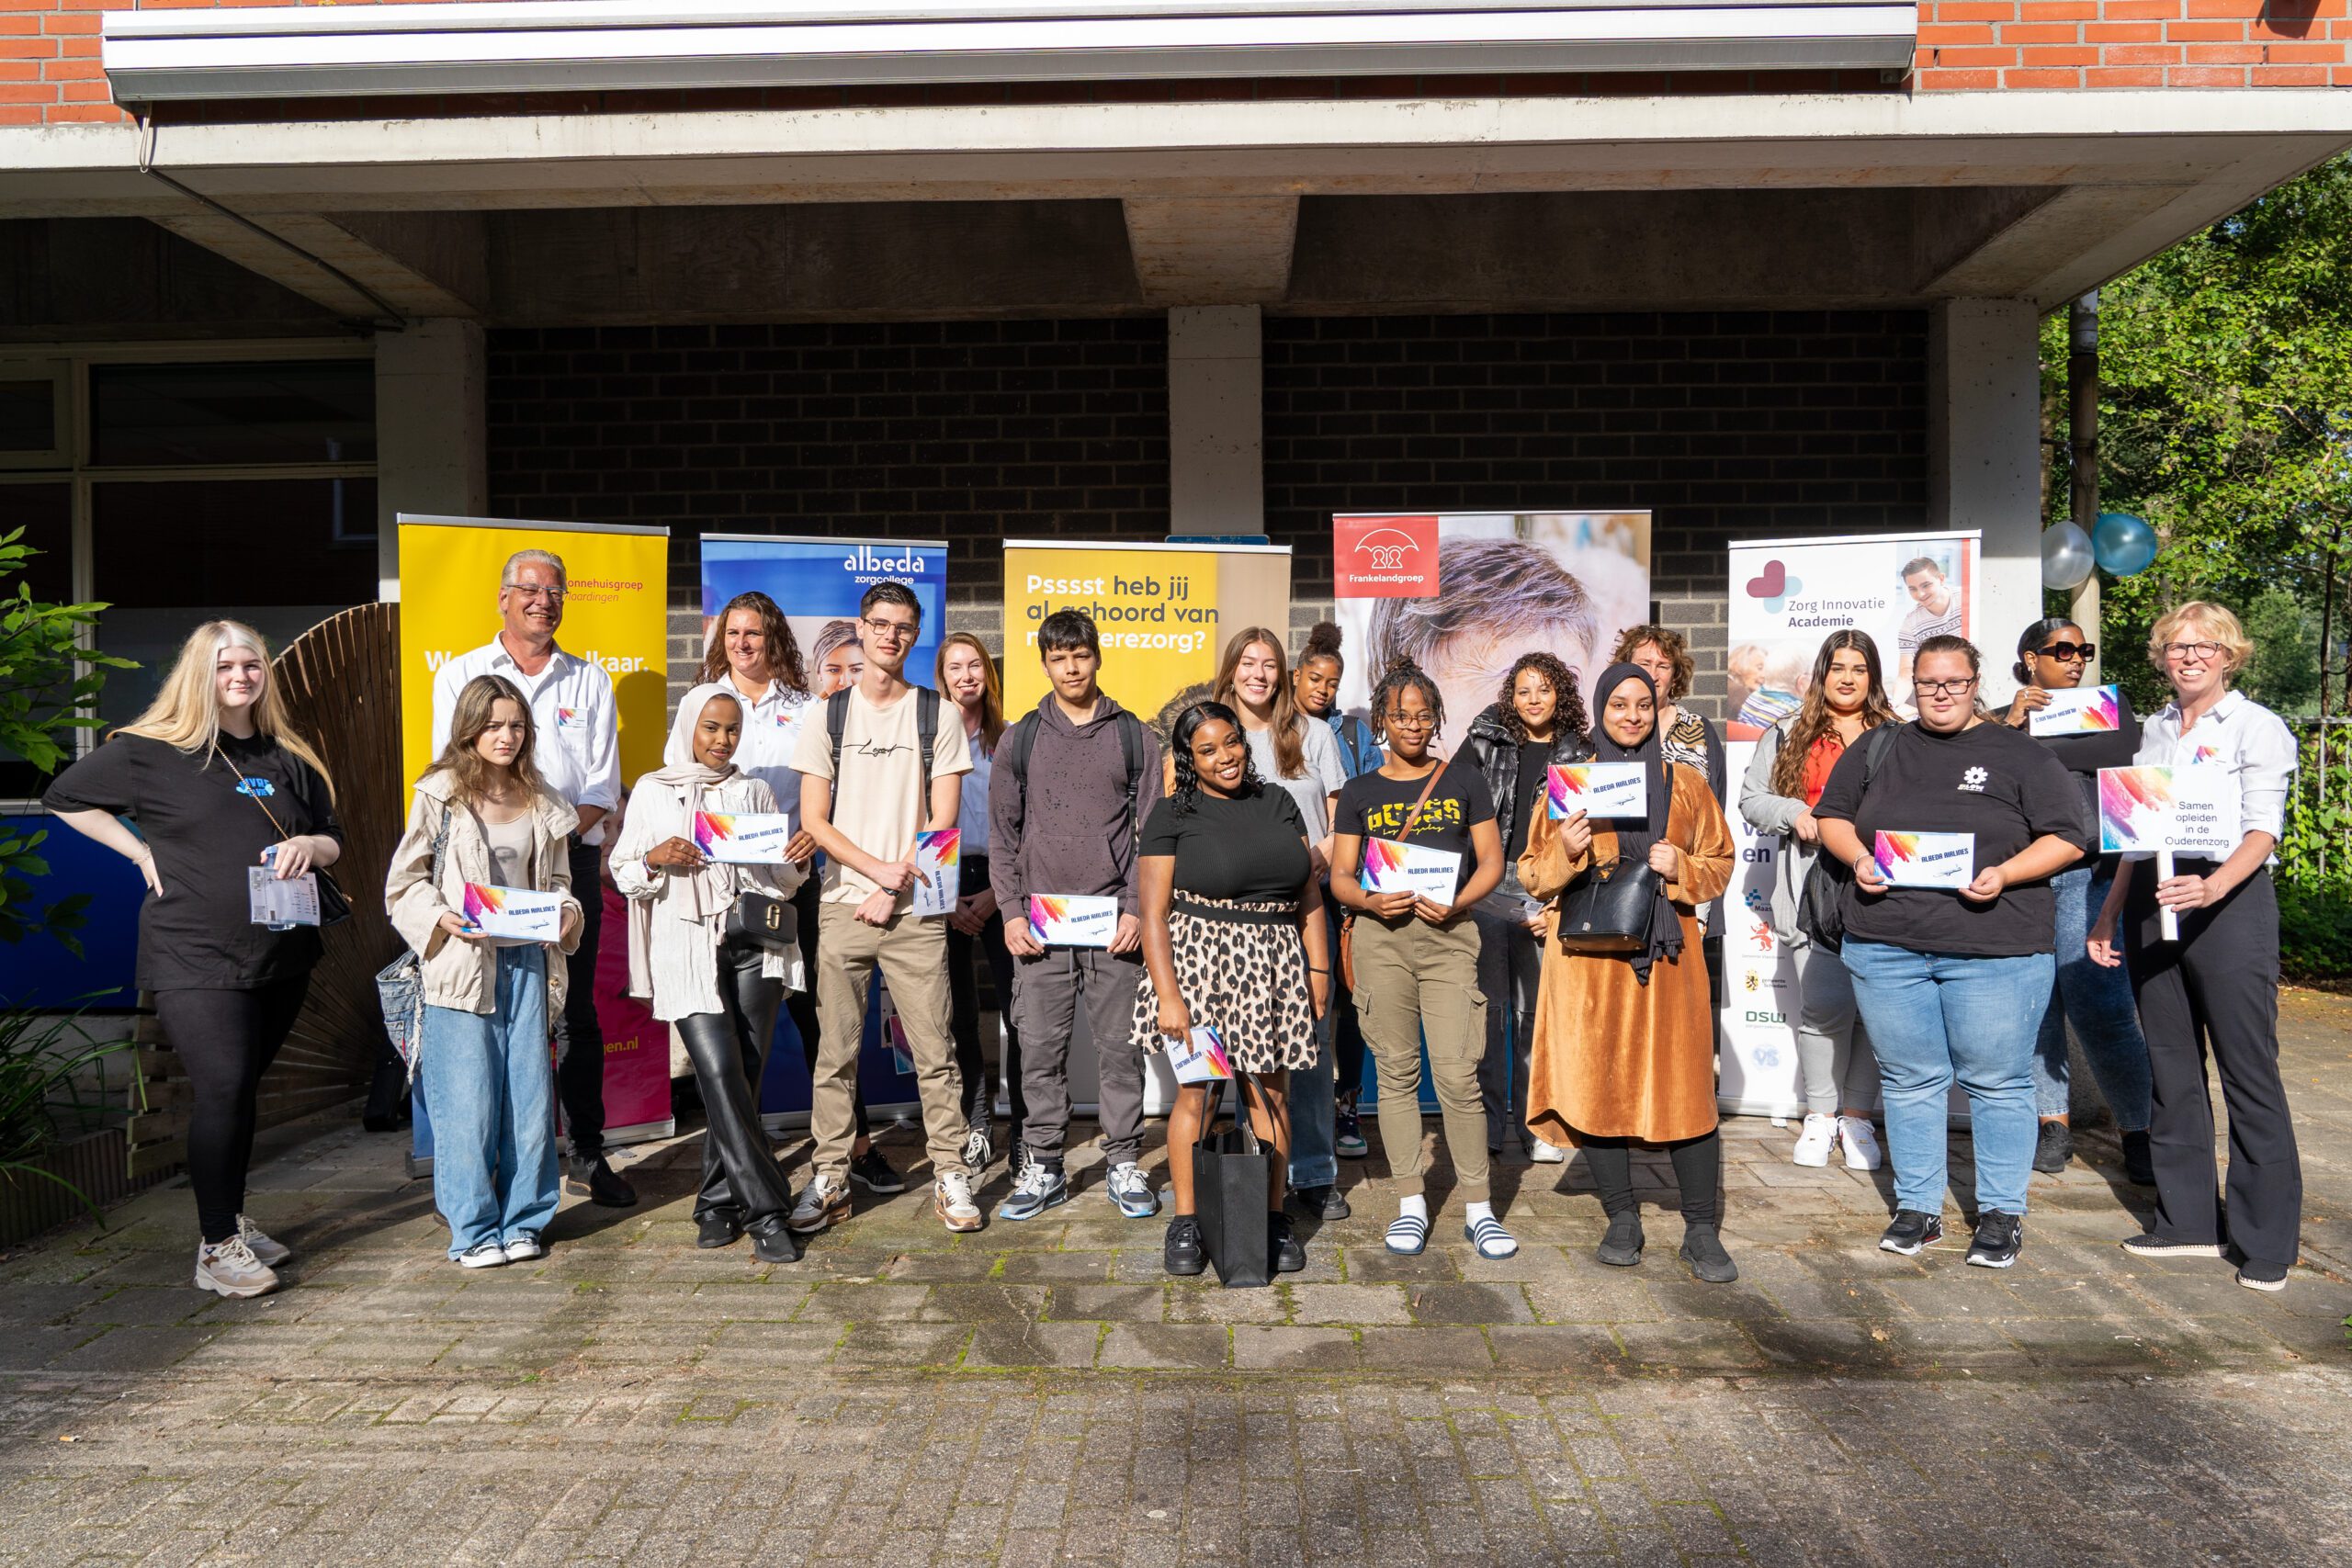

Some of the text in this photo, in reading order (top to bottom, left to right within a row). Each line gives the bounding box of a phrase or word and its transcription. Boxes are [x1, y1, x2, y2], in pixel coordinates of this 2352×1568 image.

[843, 545, 924, 572] albeda
[567, 578, 643, 592] onnehuisgroep
[854, 575, 914, 585] zorgcollege
[1349, 574, 1424, 584] Frankelandgroep
[1026, 574, 1189, 601] Psssst heb jij
[1026, 600, 1049, 621] al
[1173, 608, 1219, 624] van
[1788, 597, 1885, 614] Zorg Innovatie
[1788, 615, 1854, 627] Academie
[585, 650, 649, 672] lkaar.
[1593, 776, 1641, 794] ALBEDA AIRLINES
[2178, 801, 2214, 810] Samen
[2176, 814, 2218, 823] opleiden
[738, 827, 784, 841] ALBEDA AIRLINES
[1409, 823, 1445, 836] ngeles
[2186, 825, 2210, 834] in de
[2165, 836, 2230, 848] Ouderenzorg
[1742, 847, 1770, 863] en
[1921, 847, 1969, 863] ALBEDA AIRLINES
[508, 905, 556, 916] ALBEDA AIRLINES
[1070, 909, 1114, 923] ALBEDA AIRLINES
[1746, 1010, 1787, 1023] DSW
[604, 1035, 639, 1055] en.nl
